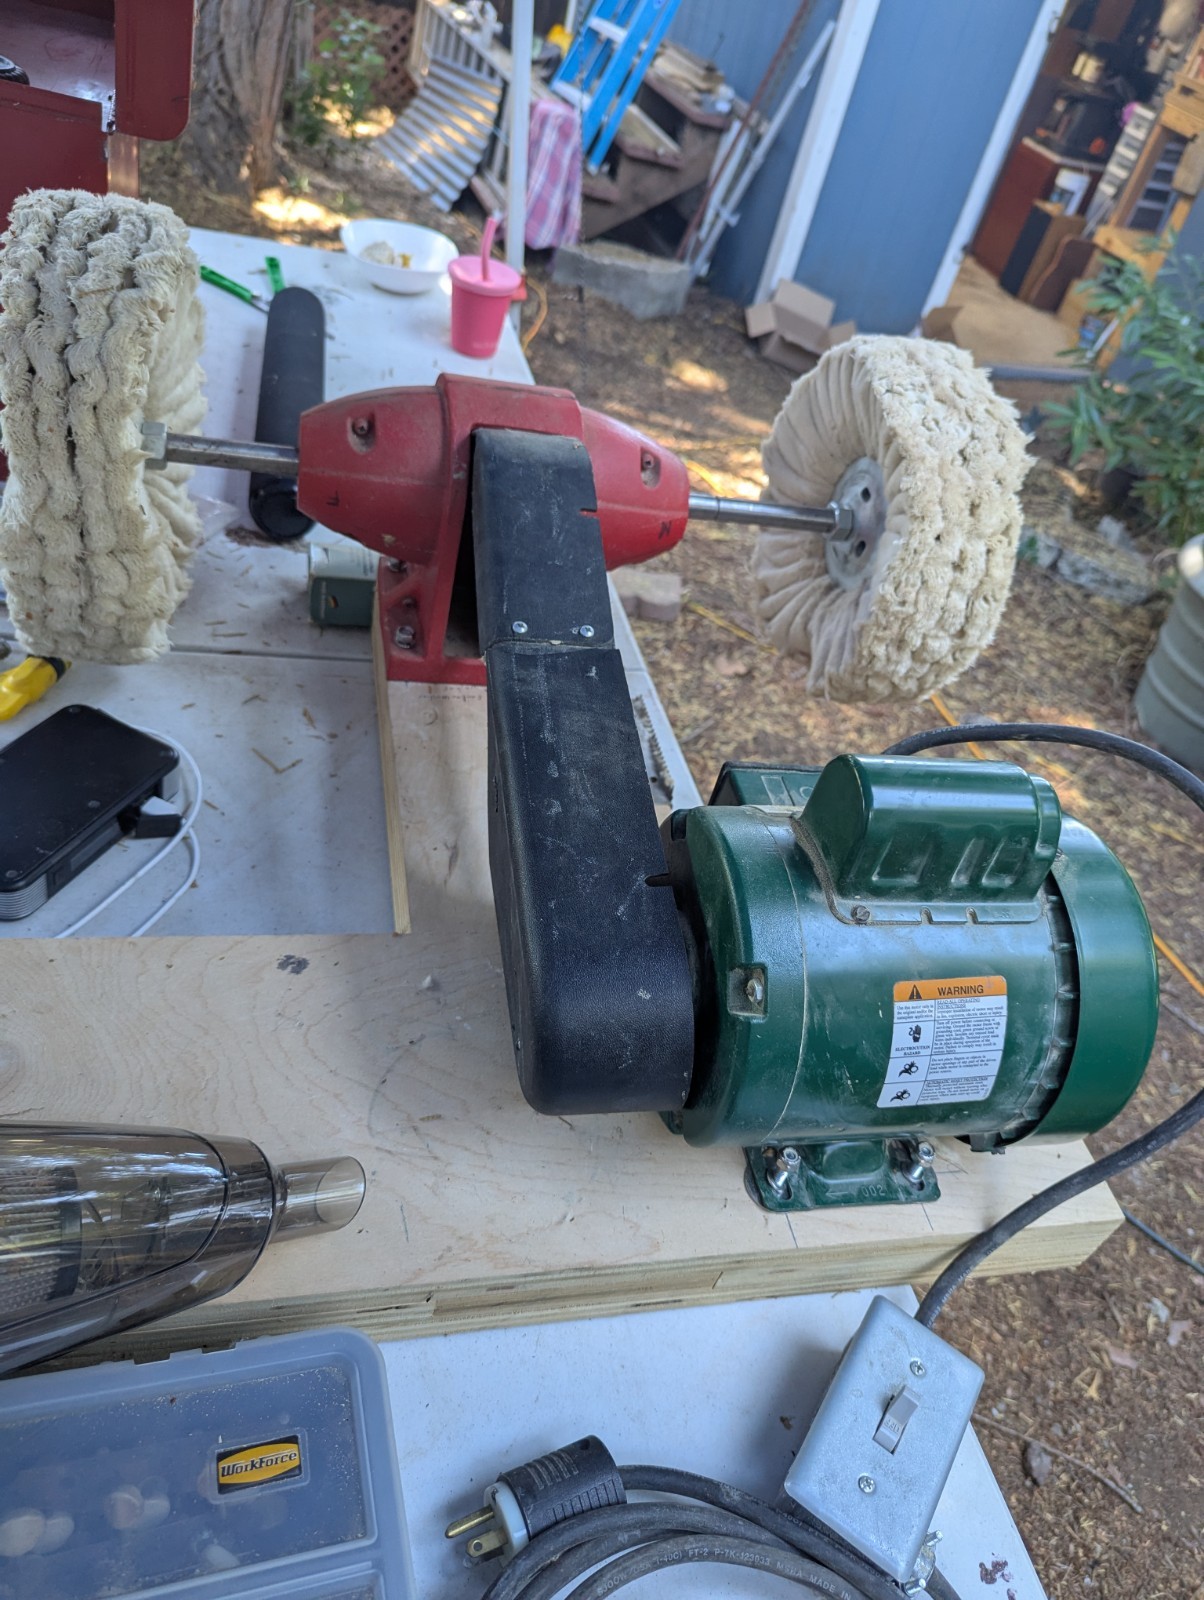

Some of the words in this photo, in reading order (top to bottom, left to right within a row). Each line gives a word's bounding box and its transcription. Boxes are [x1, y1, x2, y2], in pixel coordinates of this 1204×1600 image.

[937, 984, 984, 996] WARNING
[862, 1184, 885, 1196] 002
[221, 1450, 296, 1477] WorkForce
[688, 1548, 708, 1557] FT-2
[809, 1574, 836, 1593] MADE
[840, 1590, 852, 1600] IN
